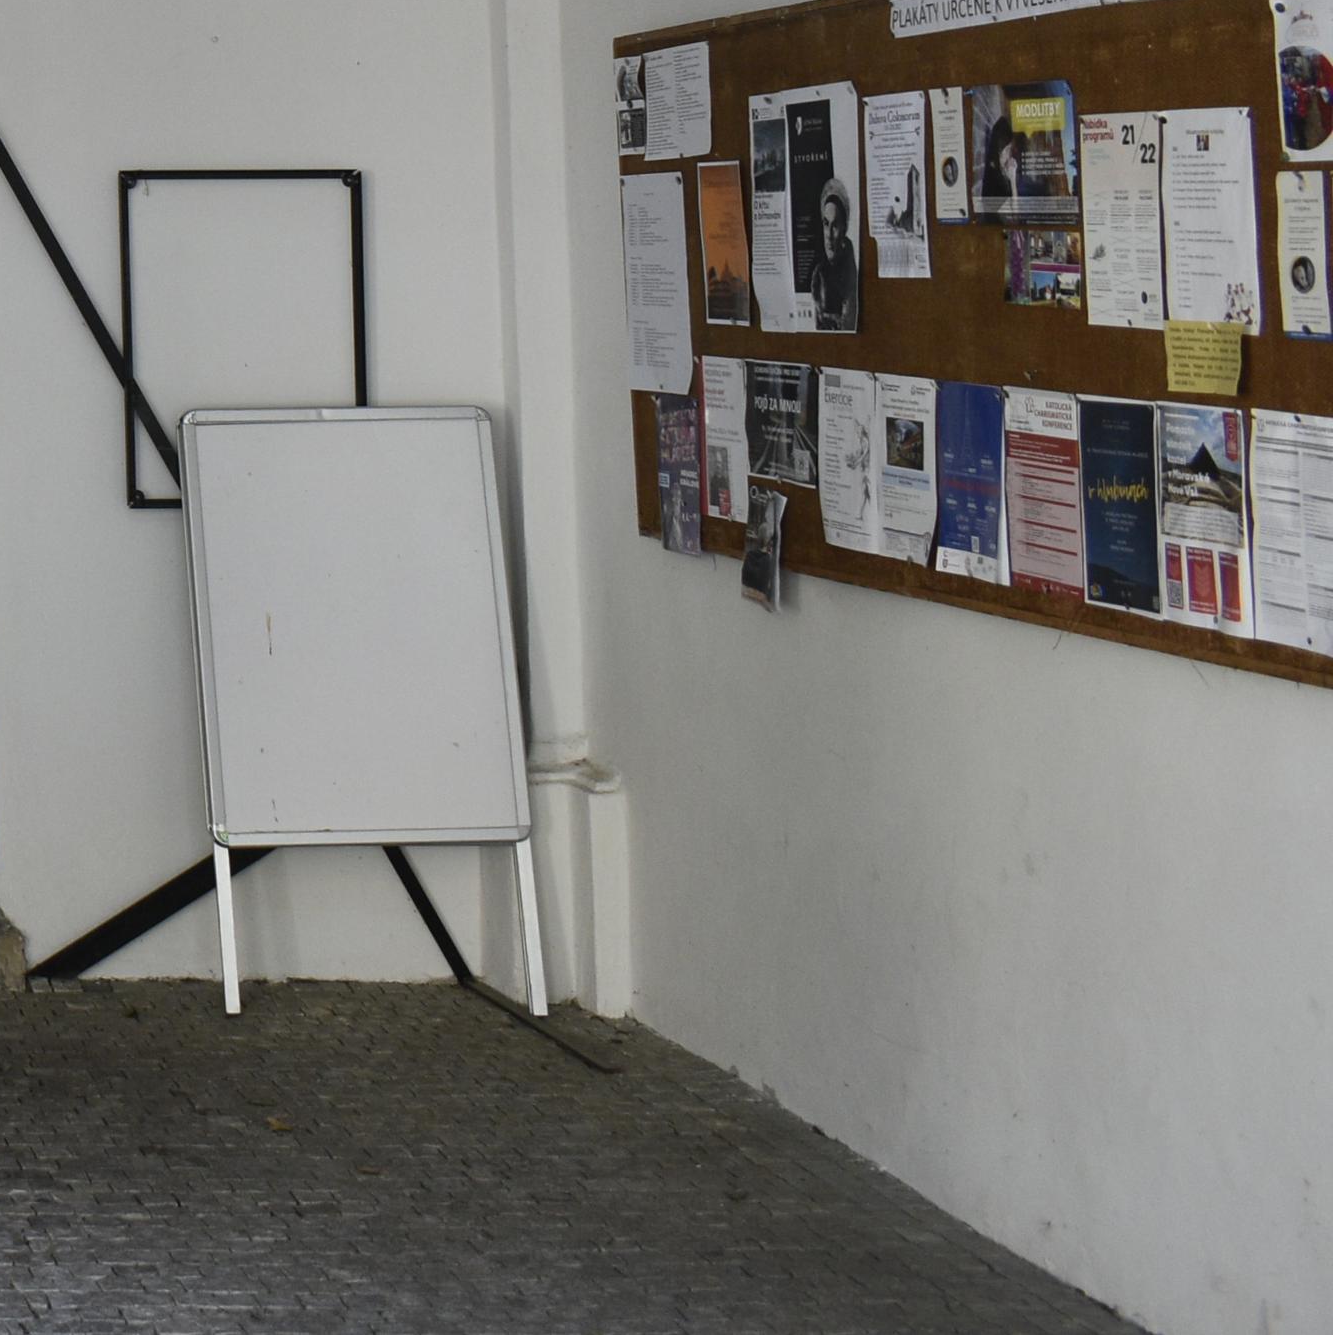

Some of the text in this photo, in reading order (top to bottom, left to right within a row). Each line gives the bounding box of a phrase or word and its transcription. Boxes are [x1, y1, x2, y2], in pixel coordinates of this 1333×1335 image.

[892, 1, 939, 29] PLAKÁTY
[1016, 101, 1061, 118] MODLITBY
[1083, 128, 1114, 143] programů
[1121, 124, 1135, 145] 21
[794, 150, 829, 163] STVOŘENÍ
[1140, 143, 1156, 164] 22
[769, 397, 778, 411] ZA
[779, 399, 802, 413] MNOU
[1045, 400, 1072, 411] KATOLICKÁ
[1034, 409, 1072, 421] CHARISMATICKÁ
[1042, 419, 1072, 431] KONFERENCE
[1096, 475, 1149, 503] hlubinách
